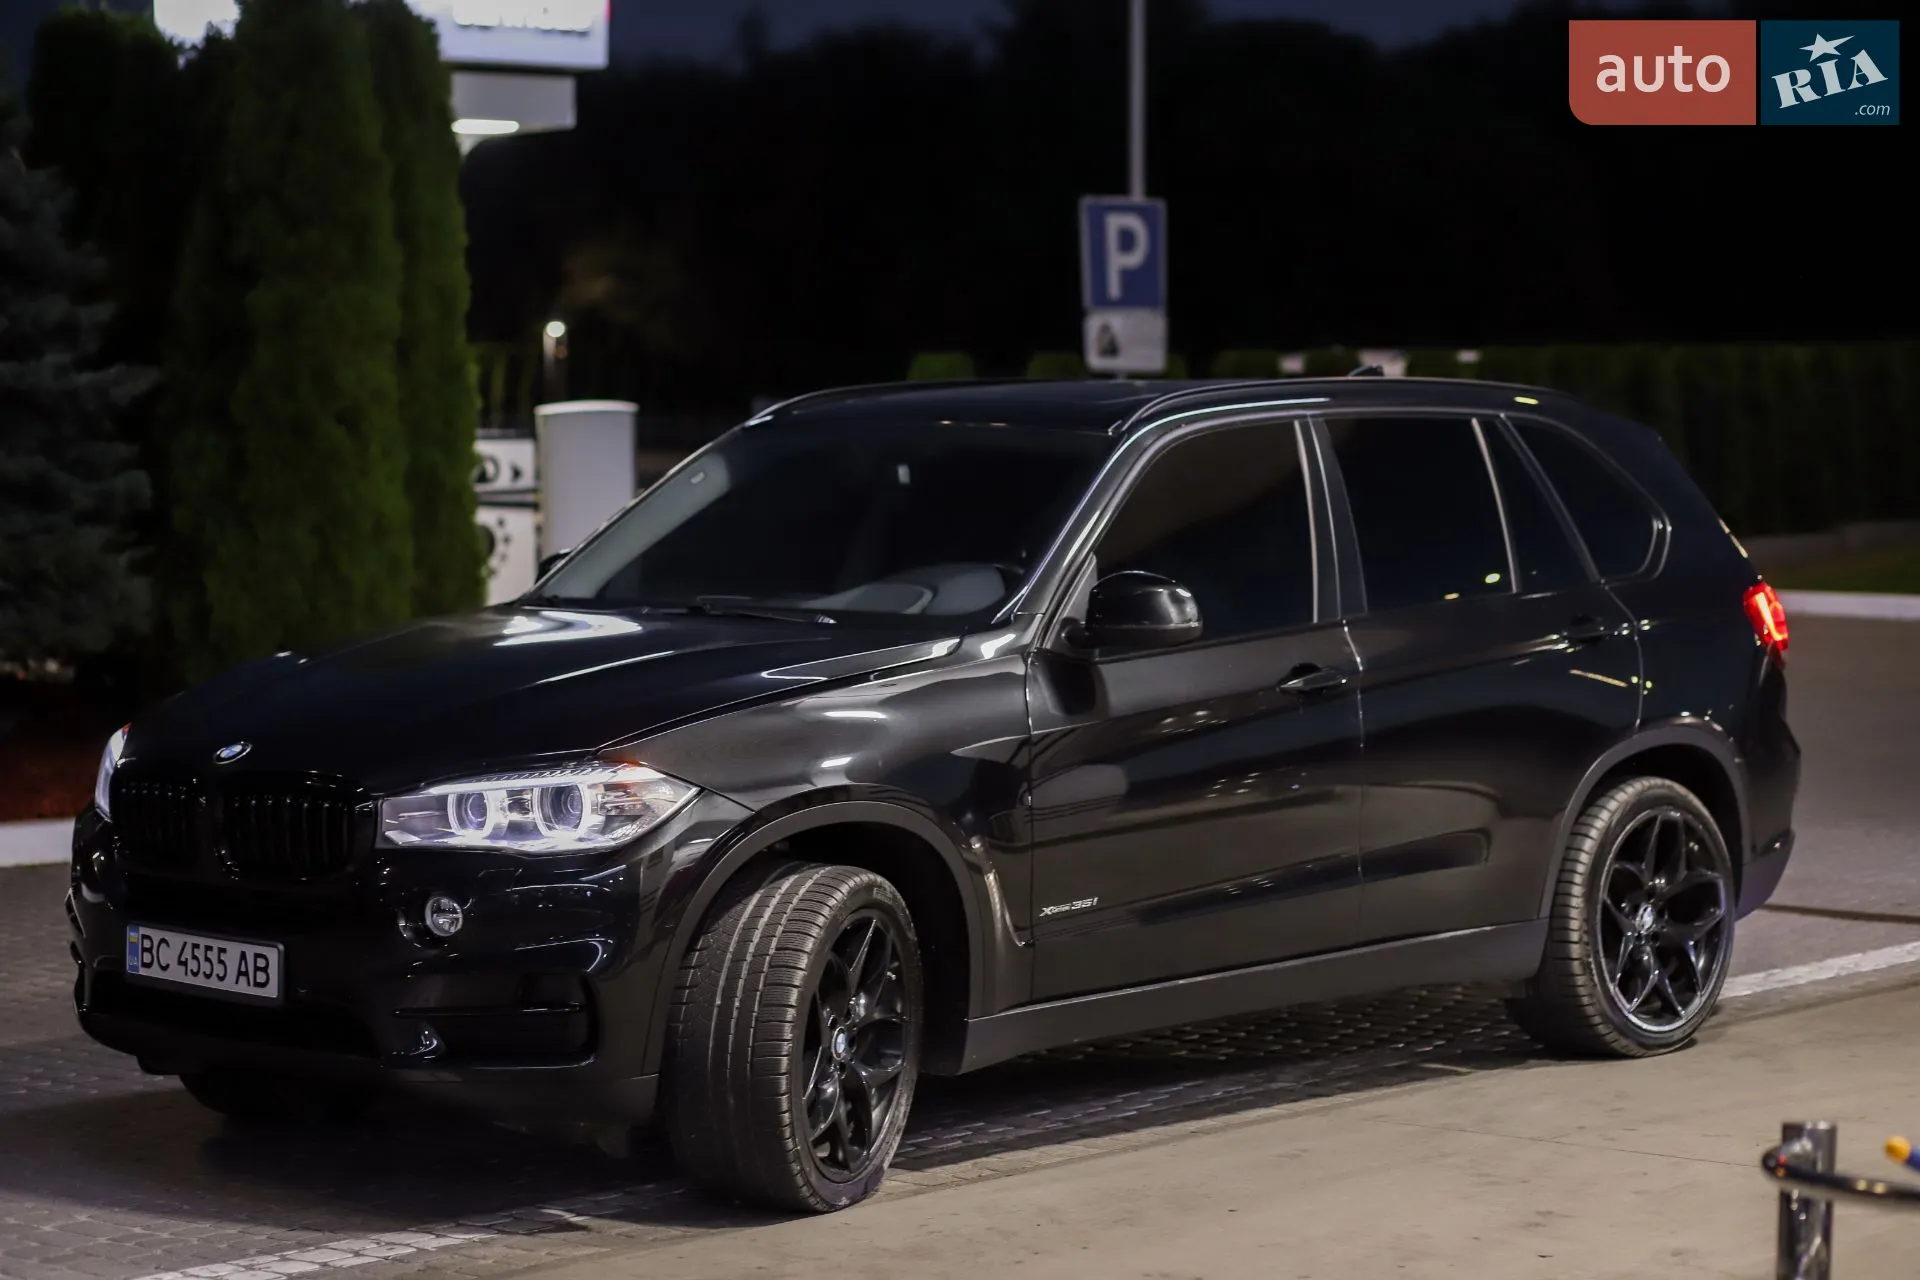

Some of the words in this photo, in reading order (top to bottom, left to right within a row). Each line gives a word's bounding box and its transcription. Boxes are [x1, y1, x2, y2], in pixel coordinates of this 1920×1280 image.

[1105, 207, 1150, 301] P
[140, 933, 171, 972] BC
[177, 941, 228, 982] 4555
[235, 950, 271, 989] AB
